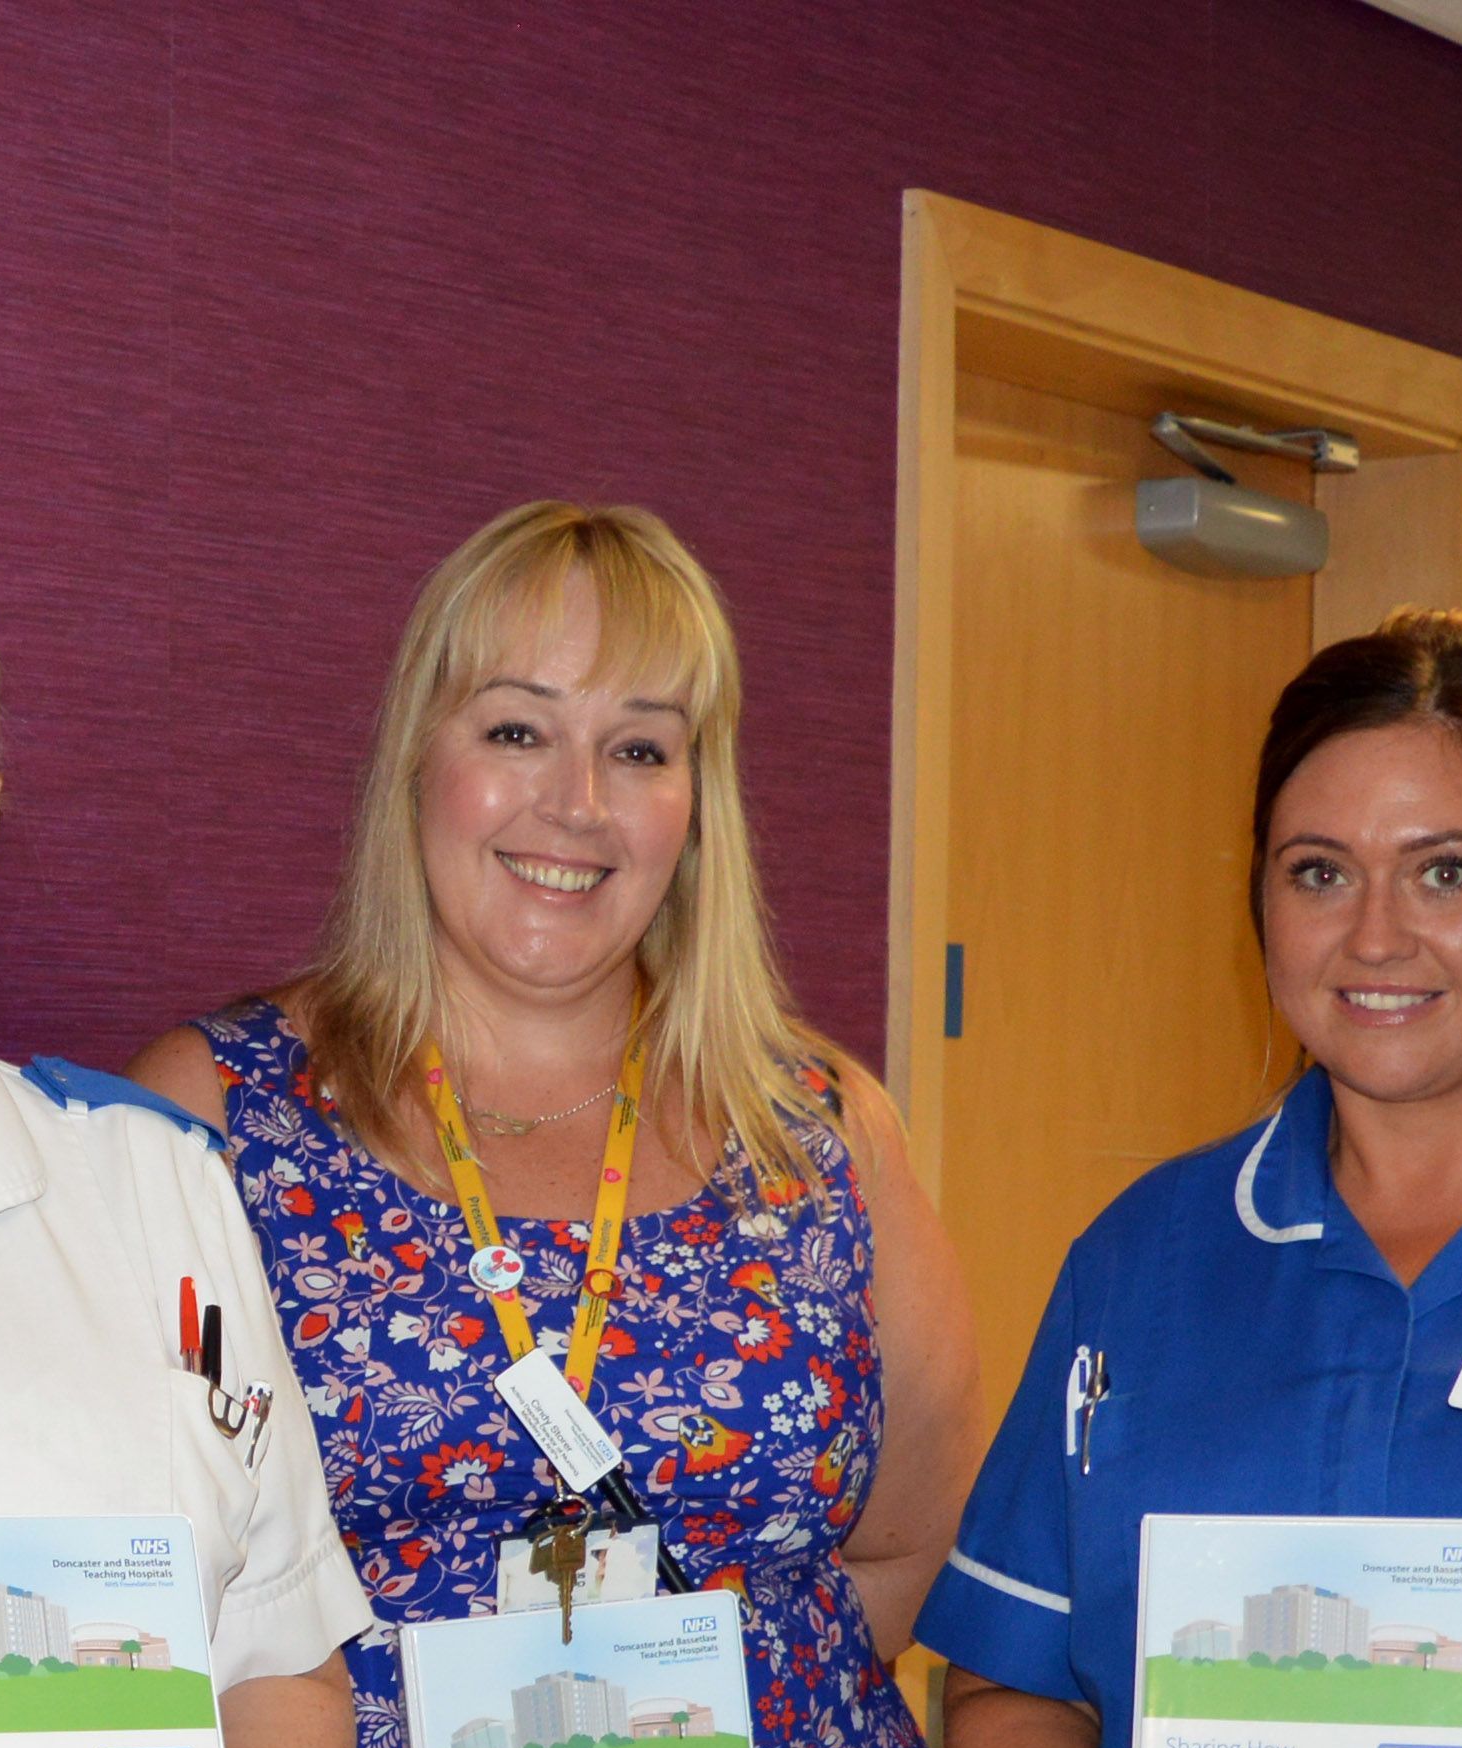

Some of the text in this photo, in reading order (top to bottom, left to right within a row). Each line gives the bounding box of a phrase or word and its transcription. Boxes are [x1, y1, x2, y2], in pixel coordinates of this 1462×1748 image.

[531, 1399, 572, 1452] Cindy Storer
[132, 1539, 167, 1555] NHS
[52, 1558, 171, 1568] Doncaster and Bassetlaw
[83, 1569, 173, 1581] Teaching Hospitals
[683, 1616, 715, 1633] NHS
